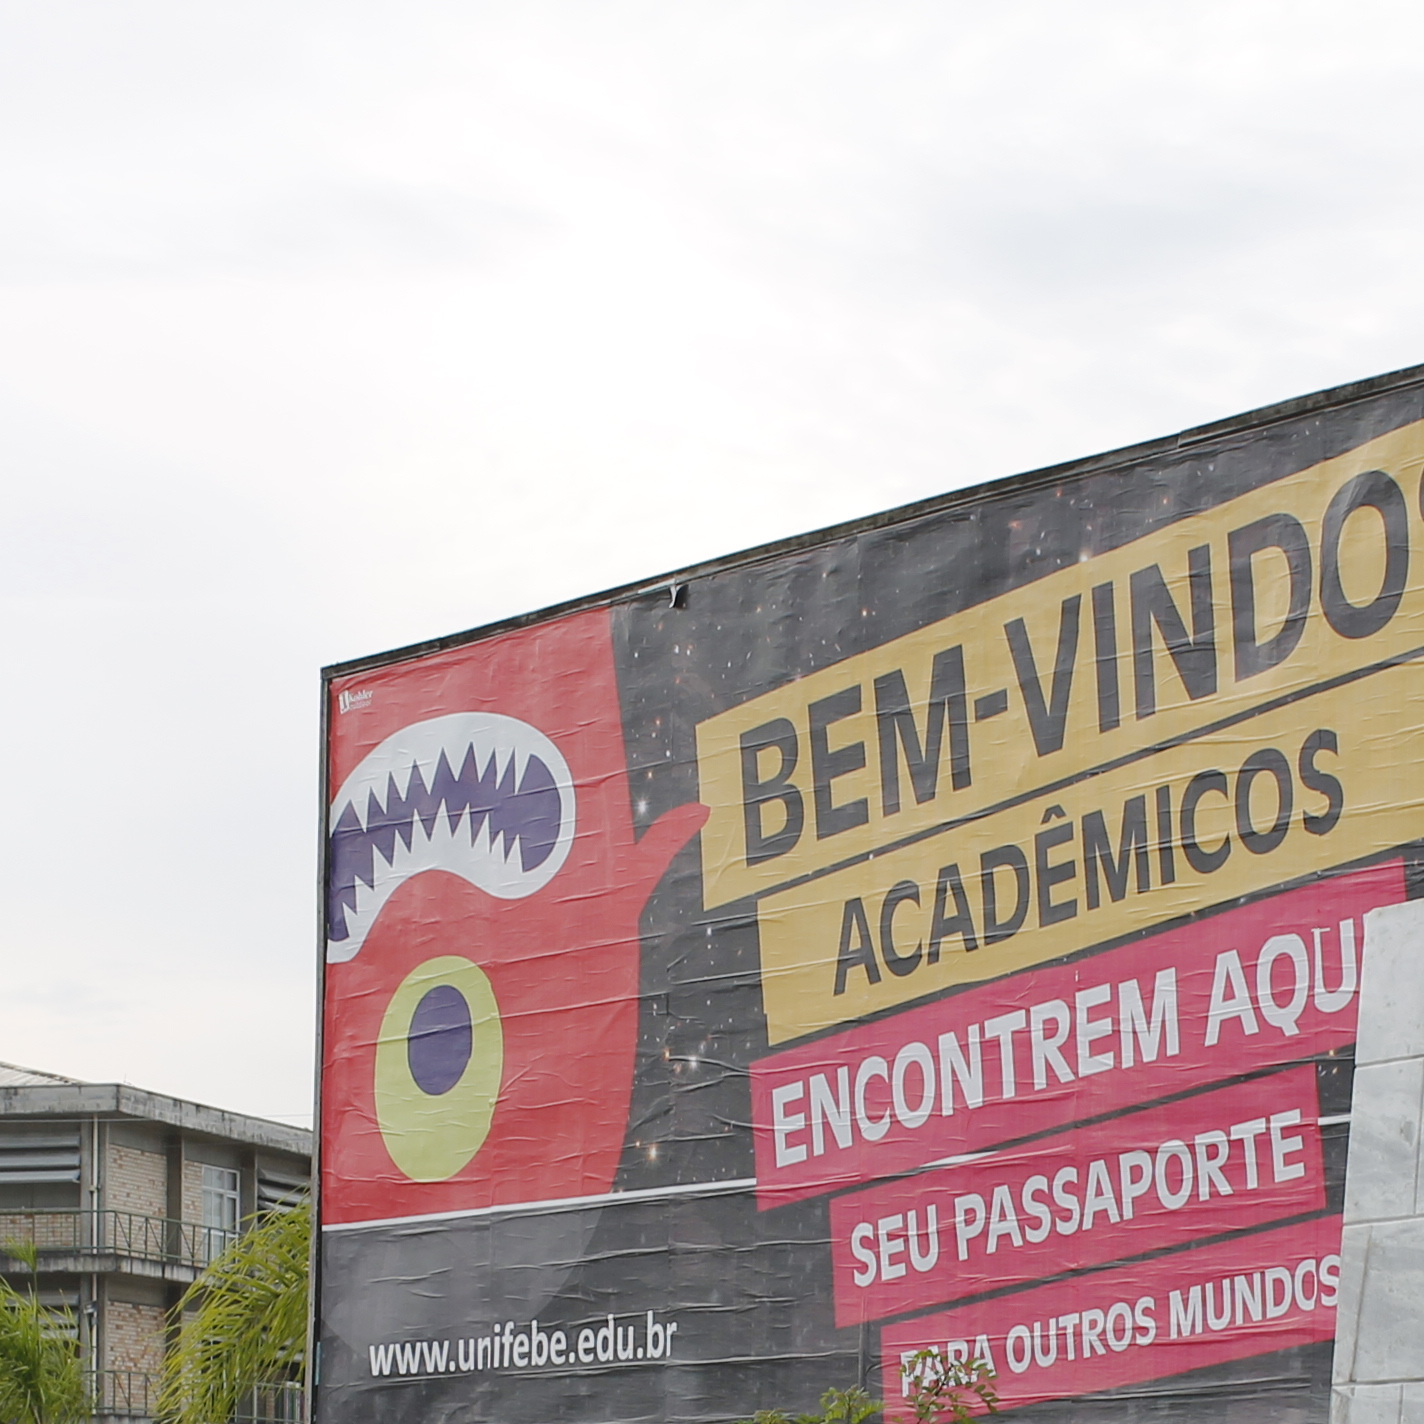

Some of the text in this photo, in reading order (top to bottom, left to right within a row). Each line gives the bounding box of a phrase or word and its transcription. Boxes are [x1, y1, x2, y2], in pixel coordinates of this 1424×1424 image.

[833, 728, 1344, 996] ACADÊMICOS
[771, 917, 1357, 1168] ENCONTREM AQU
[850, 1108, 1305, 1288] SEU PASSAPORTE
[368, 1310, 678, 1377] www.unifebe.edu.br
[900, 1254, 1341, 1398] PARA OUTROS MUNDOS
